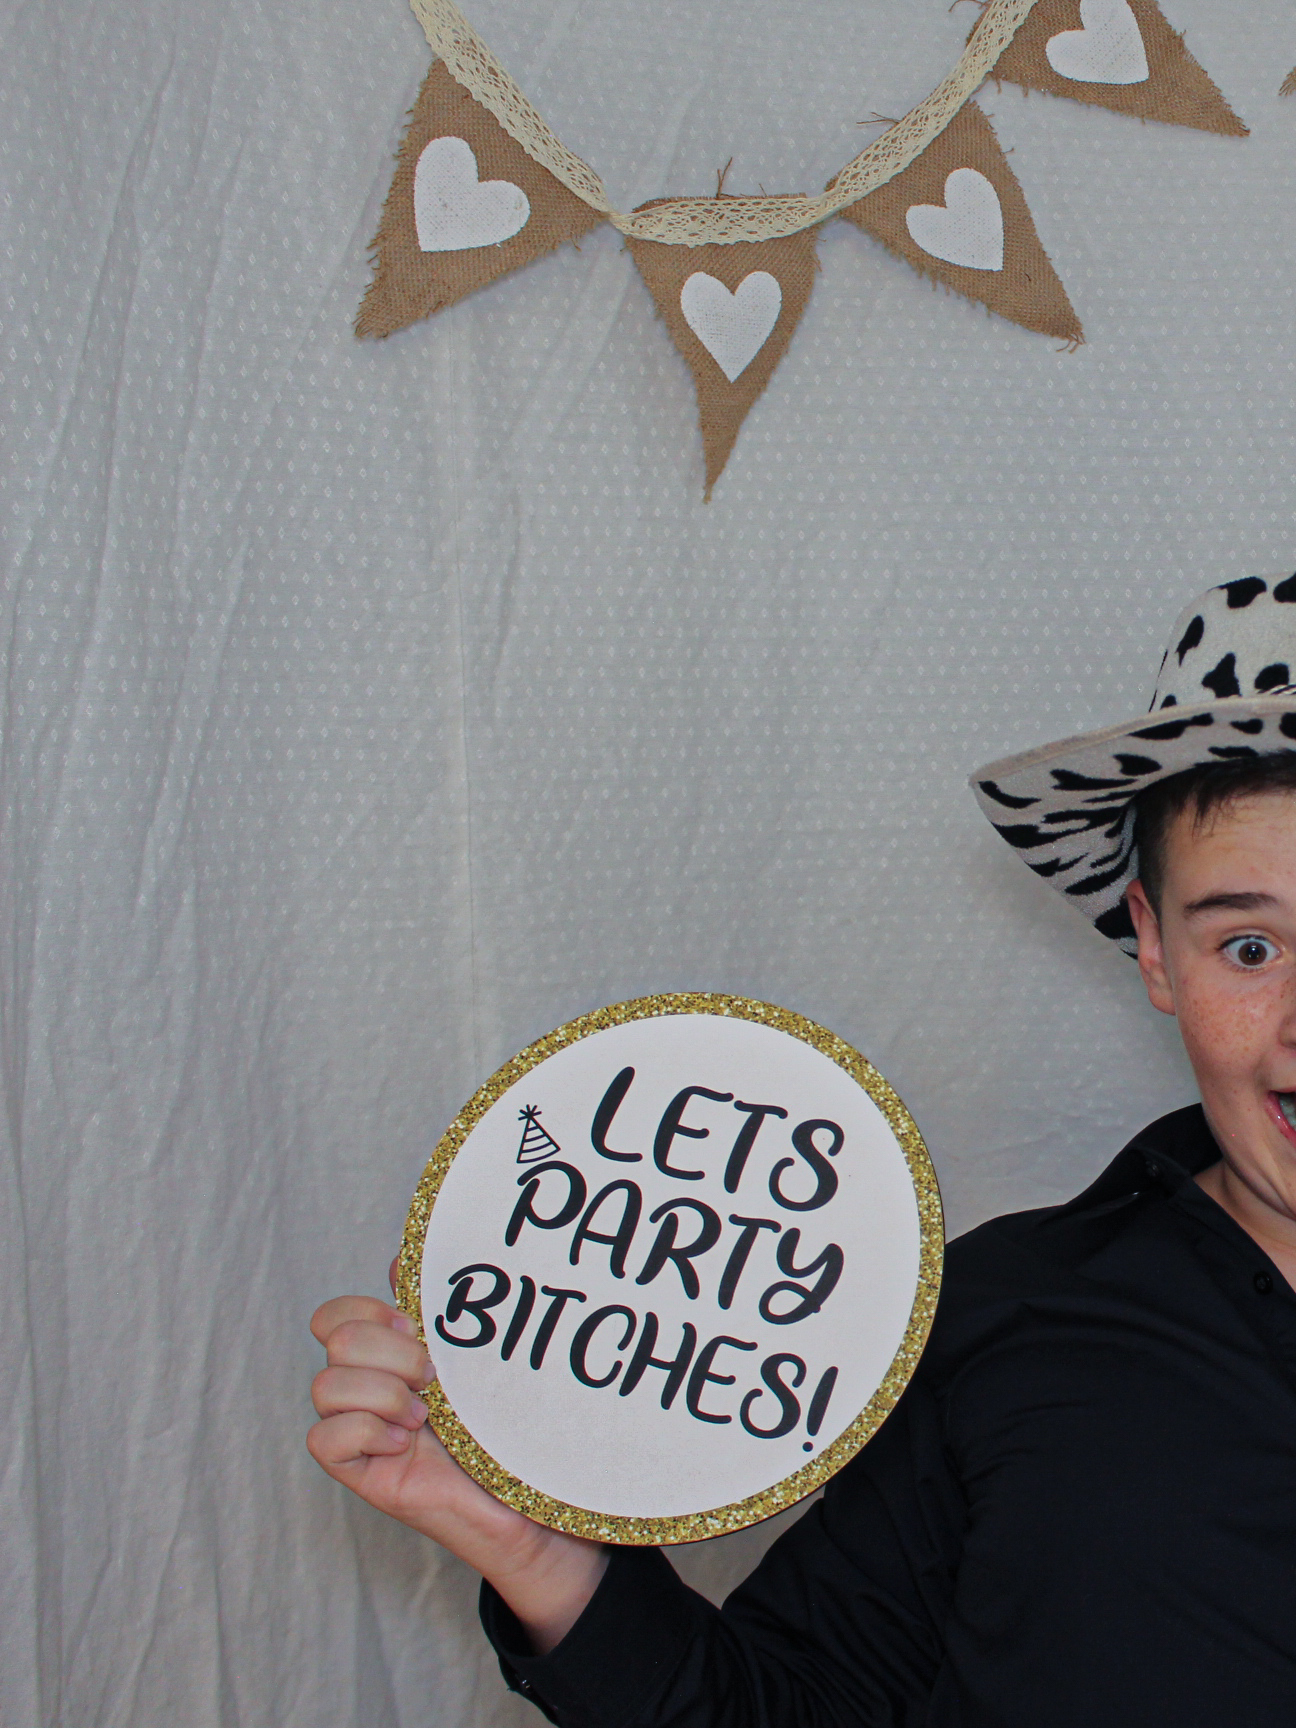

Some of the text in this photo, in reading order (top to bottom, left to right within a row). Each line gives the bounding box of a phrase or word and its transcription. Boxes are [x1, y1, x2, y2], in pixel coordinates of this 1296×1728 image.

[590, 1066, 845, 1212] LETS
[504, 1160, 845, 1325] PARTY
[434, 1263, 839, 1452] BITCHES!
